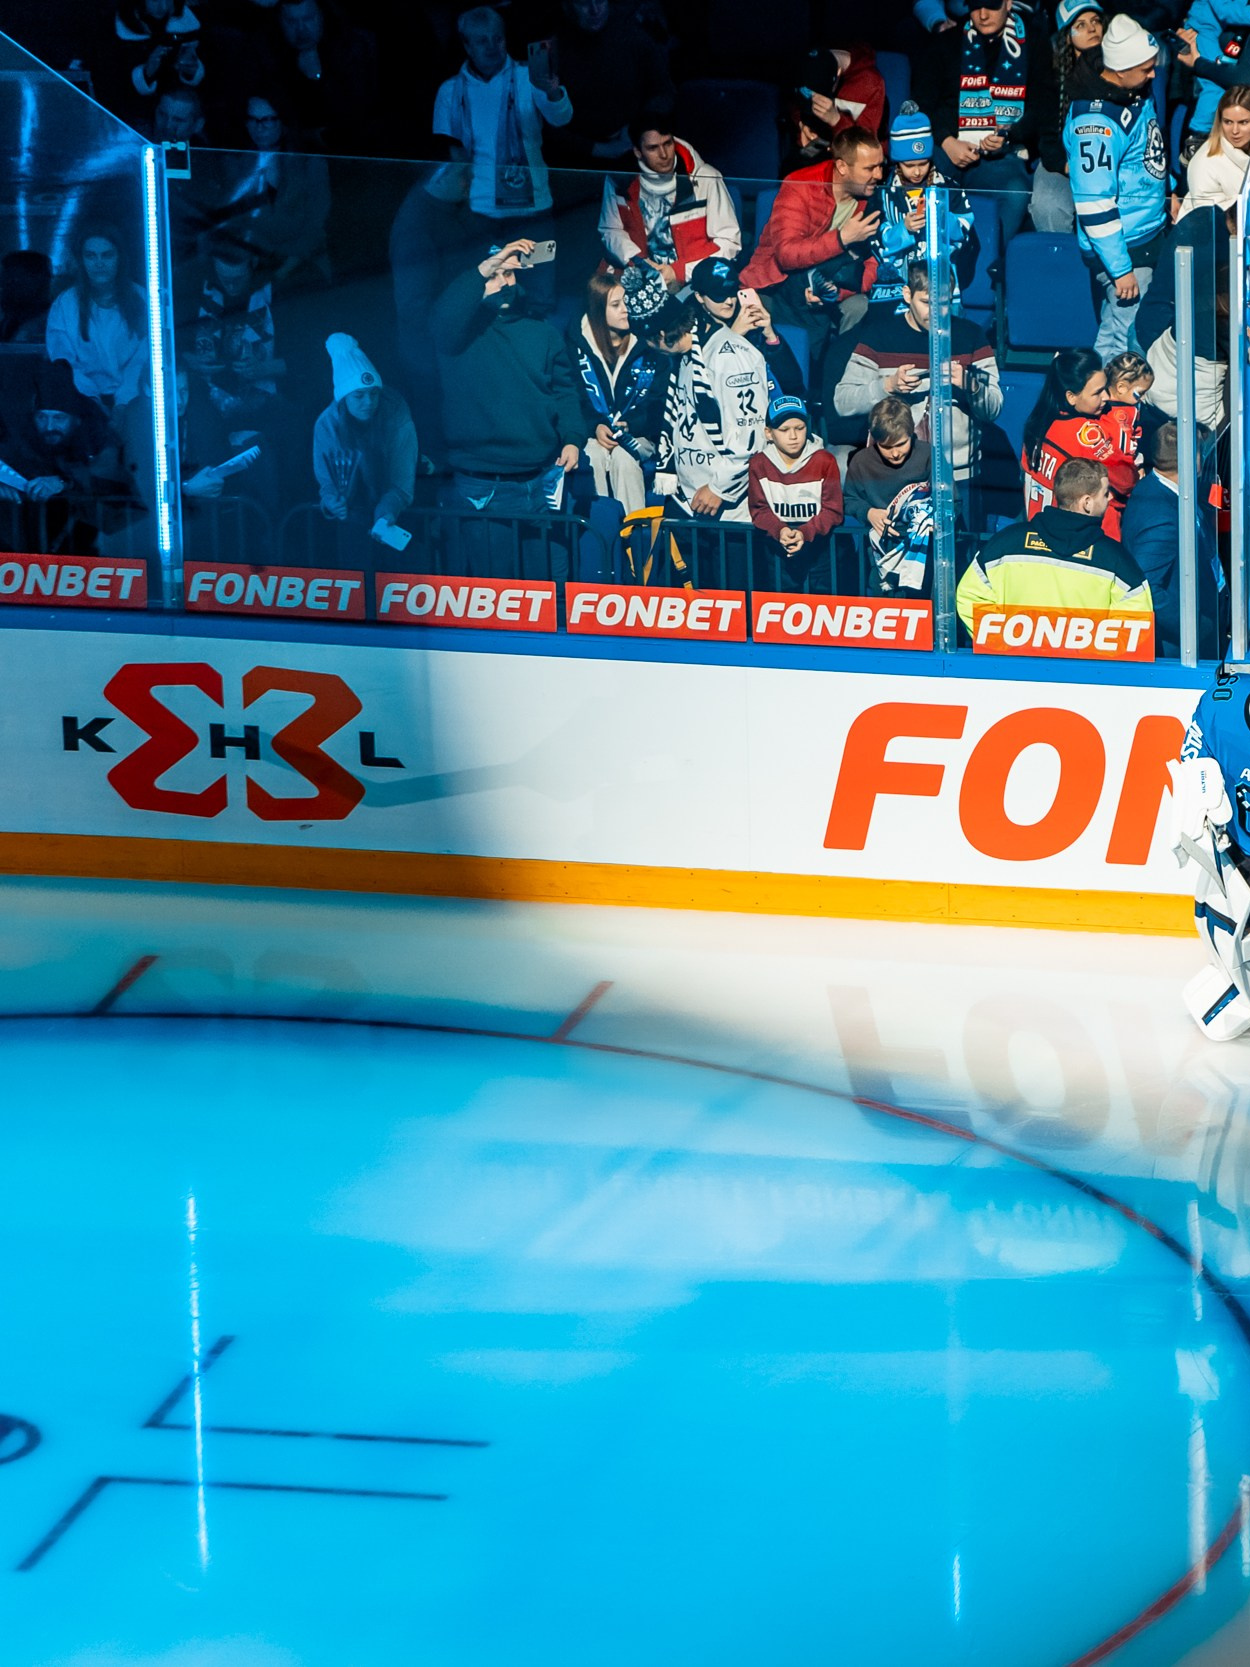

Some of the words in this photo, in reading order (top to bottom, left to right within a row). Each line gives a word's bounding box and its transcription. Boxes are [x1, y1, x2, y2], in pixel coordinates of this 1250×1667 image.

[989, 86, 1024, 97] FONBET
[1079, 140, 1112, 174] 54
[188, 571, 361, 612] FONBET
[379, 581, 552, 622] FONBET
[569, 592, 744, 634] FONBET
[756, 602, 929, 641] FONBET
[975, 612, 1150, 653] FONBET
